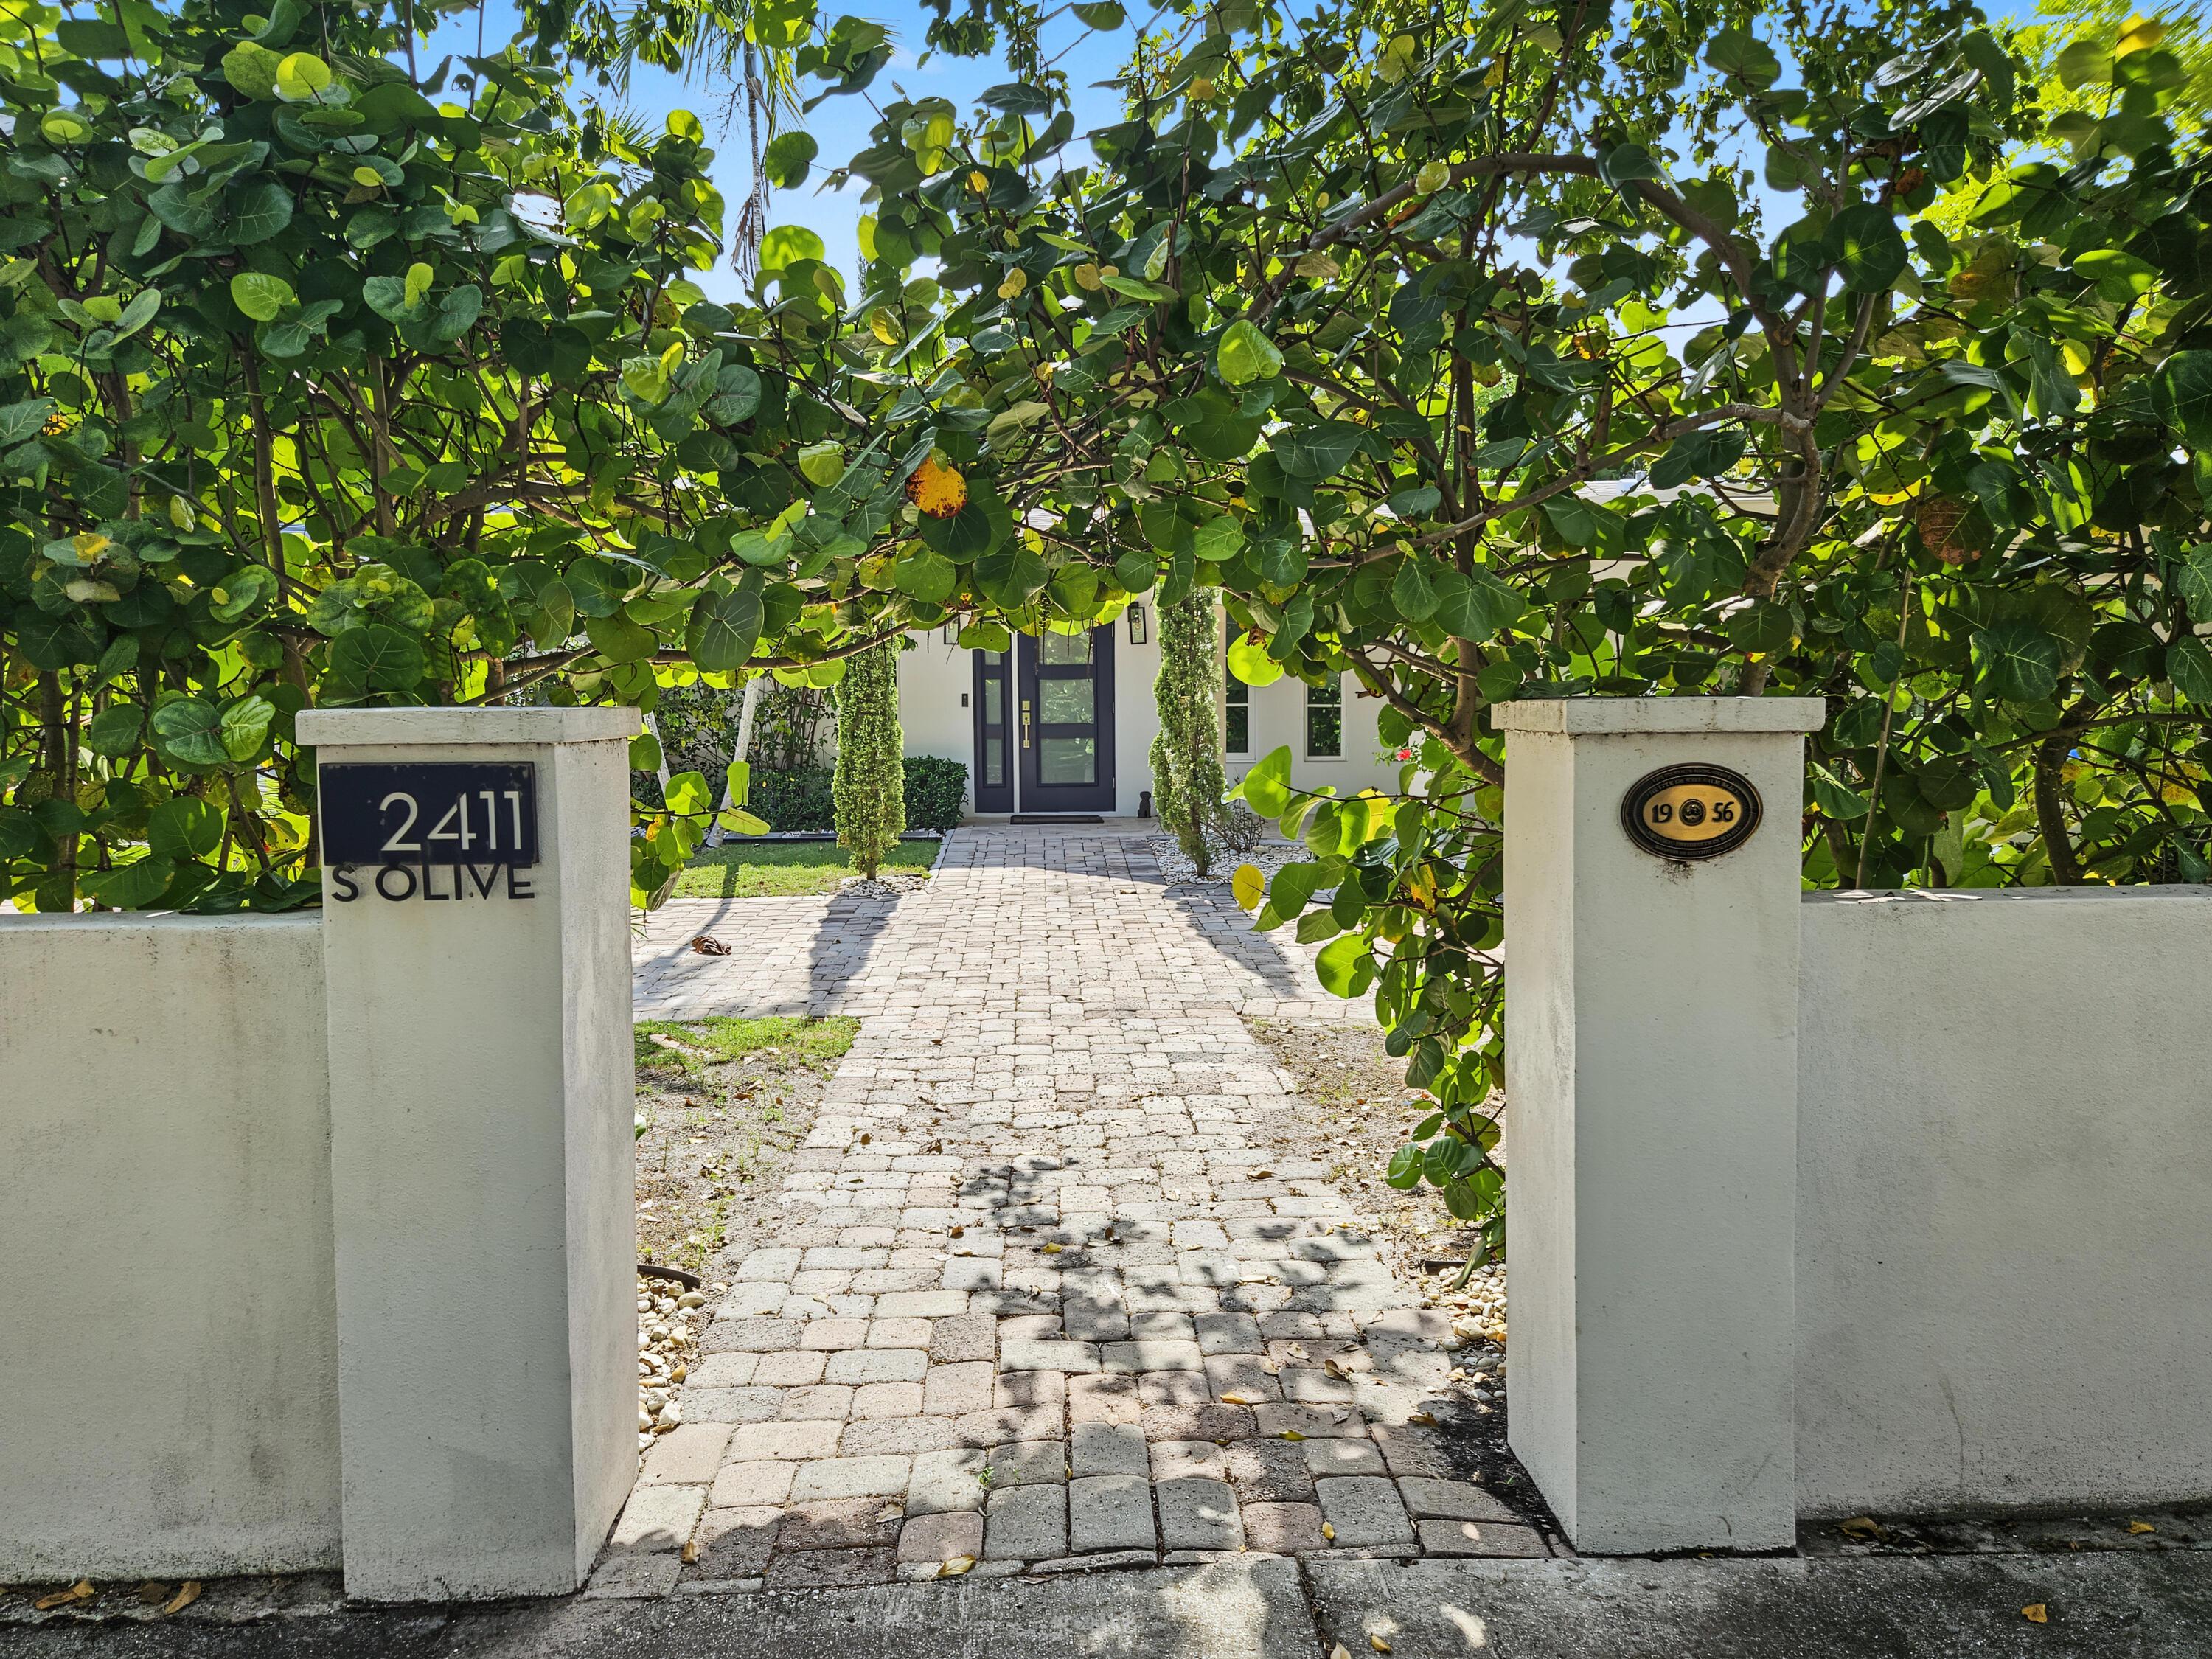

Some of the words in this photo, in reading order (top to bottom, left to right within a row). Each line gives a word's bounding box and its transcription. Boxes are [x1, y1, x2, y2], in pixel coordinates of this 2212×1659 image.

[379, 790, 521, 852] 2411
[1651, 804, 1673, 824] 19
[1711, 801, 1735, 823] 56
[331, 864, 360, 902] S
[375, 863, 536, 902] OLIVE
